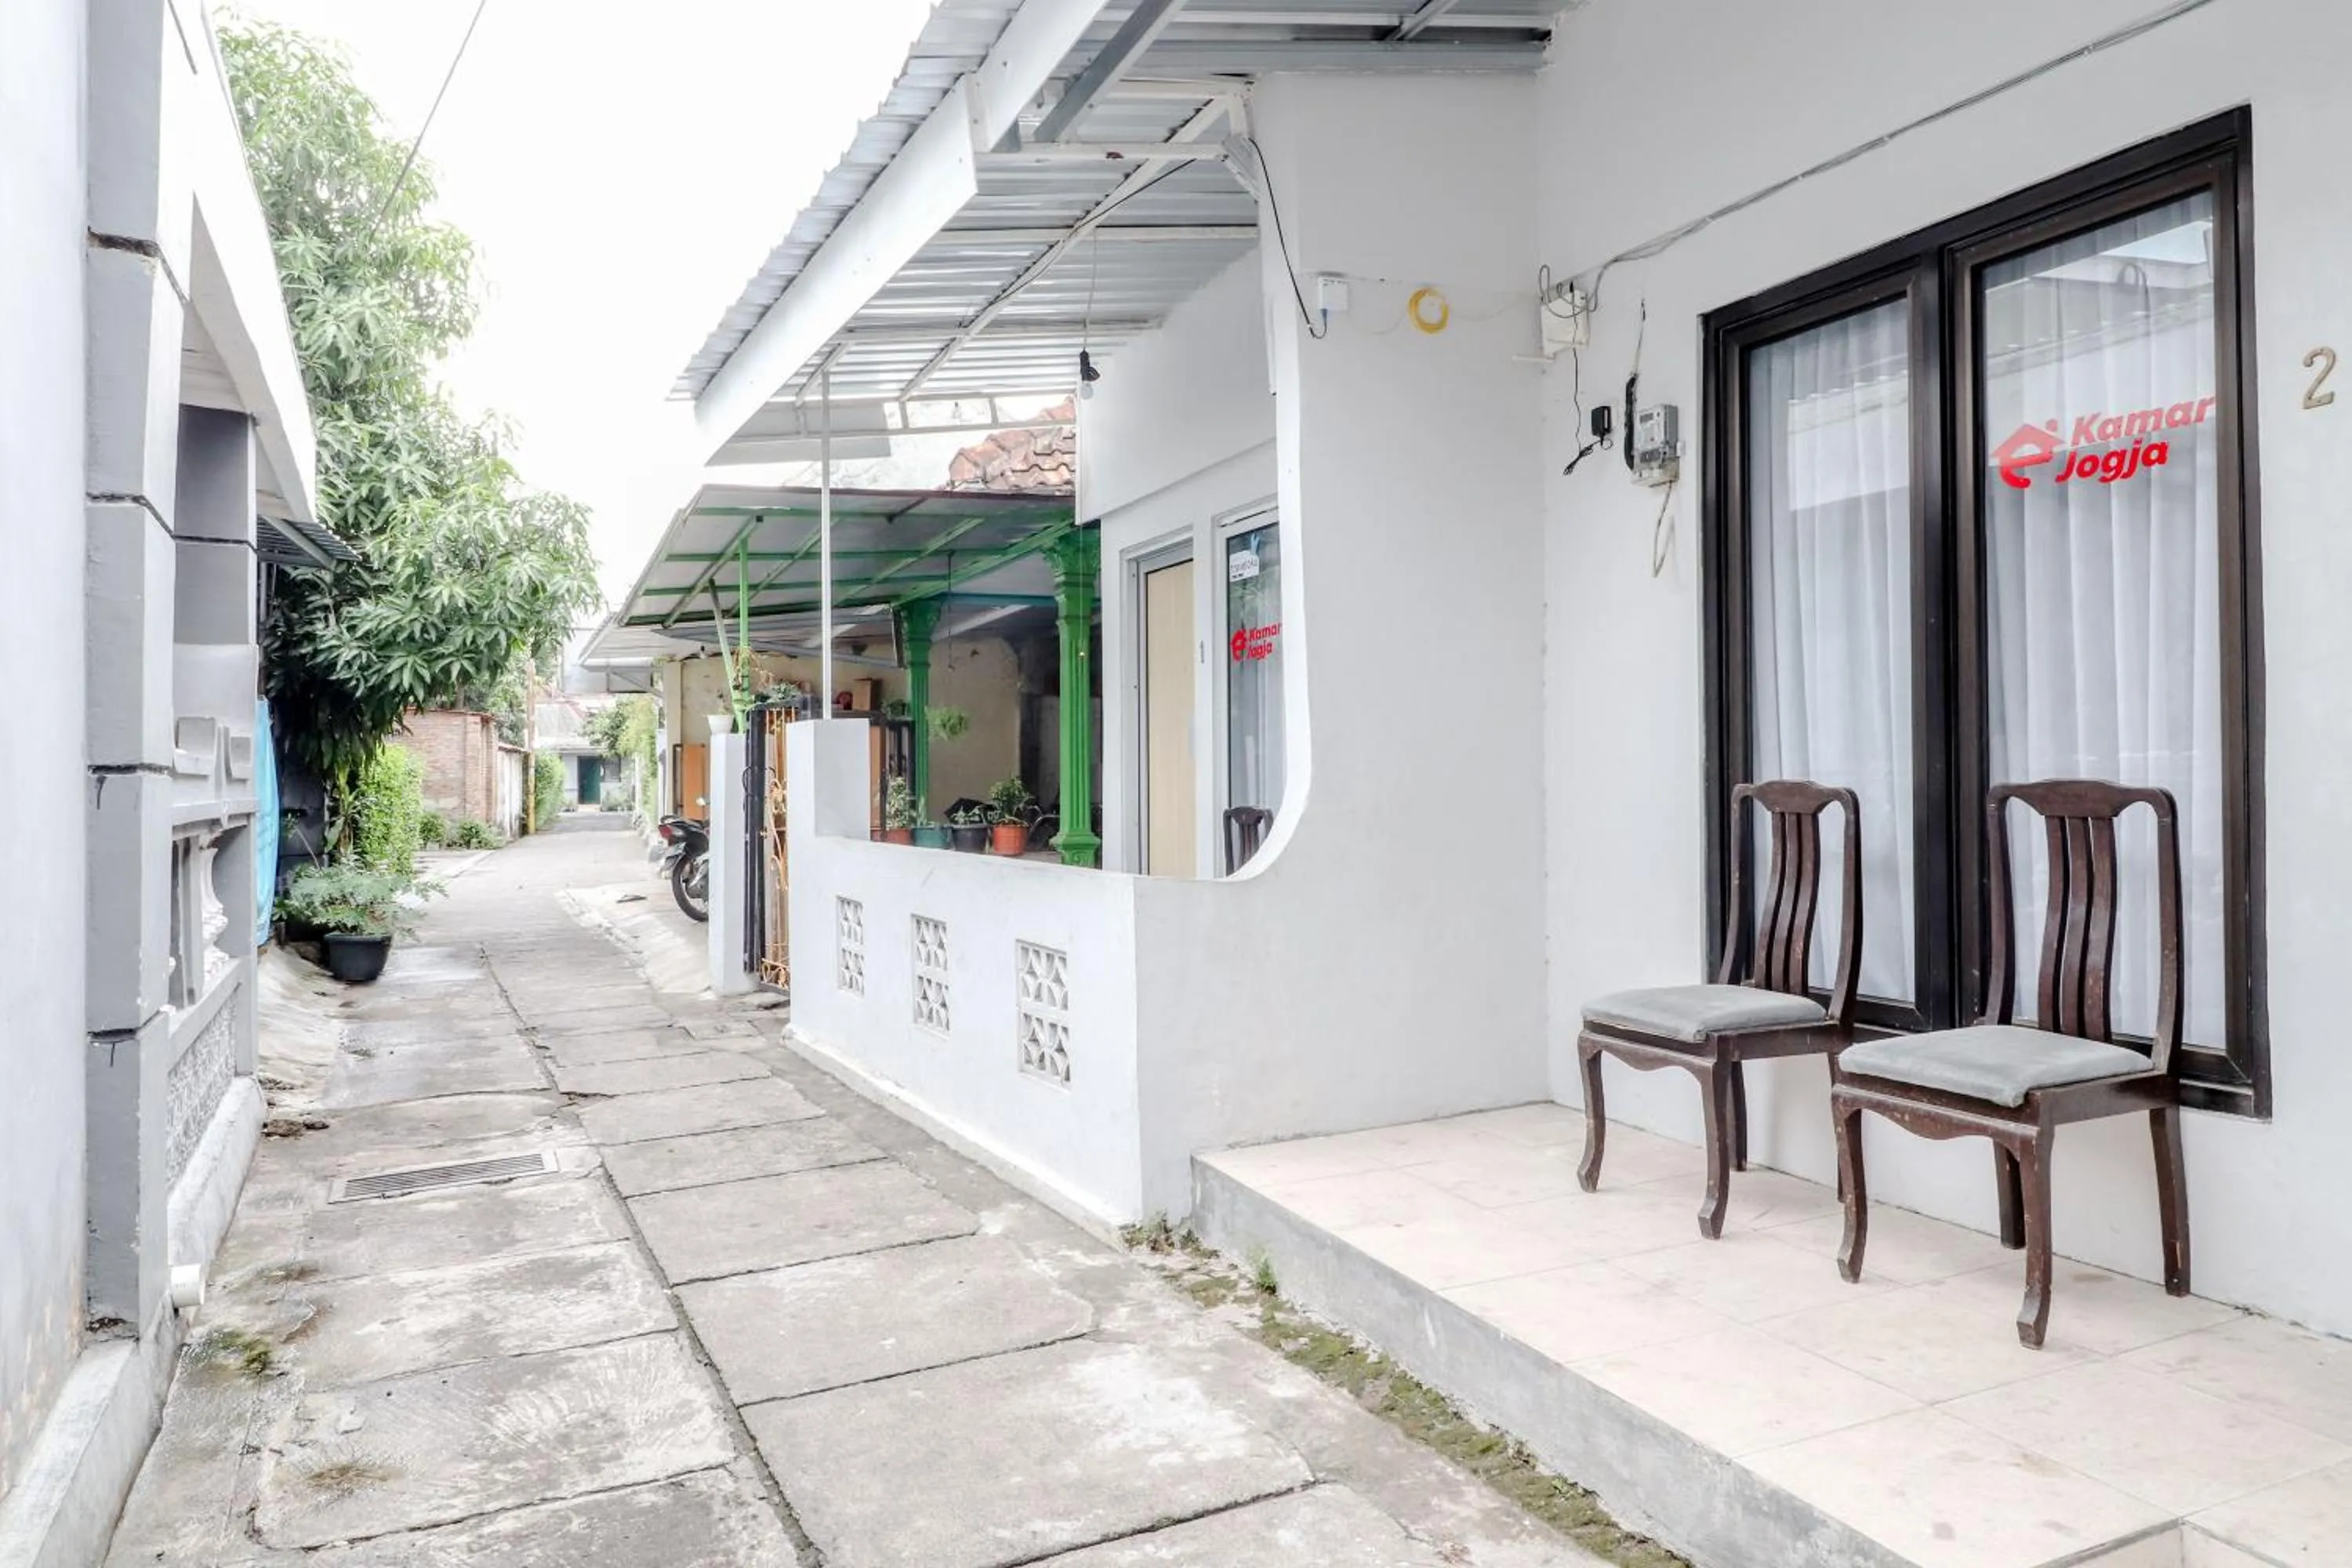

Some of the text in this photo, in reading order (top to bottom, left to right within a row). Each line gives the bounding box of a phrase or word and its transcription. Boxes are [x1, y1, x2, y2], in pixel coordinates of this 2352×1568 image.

[2303, 347, 2336, 409] 2
[2071, 395, 2216, 447] Kamar
[2055, 437, 2169, 483] Jogja
[1249, 623, 1281, 641] Kamar
